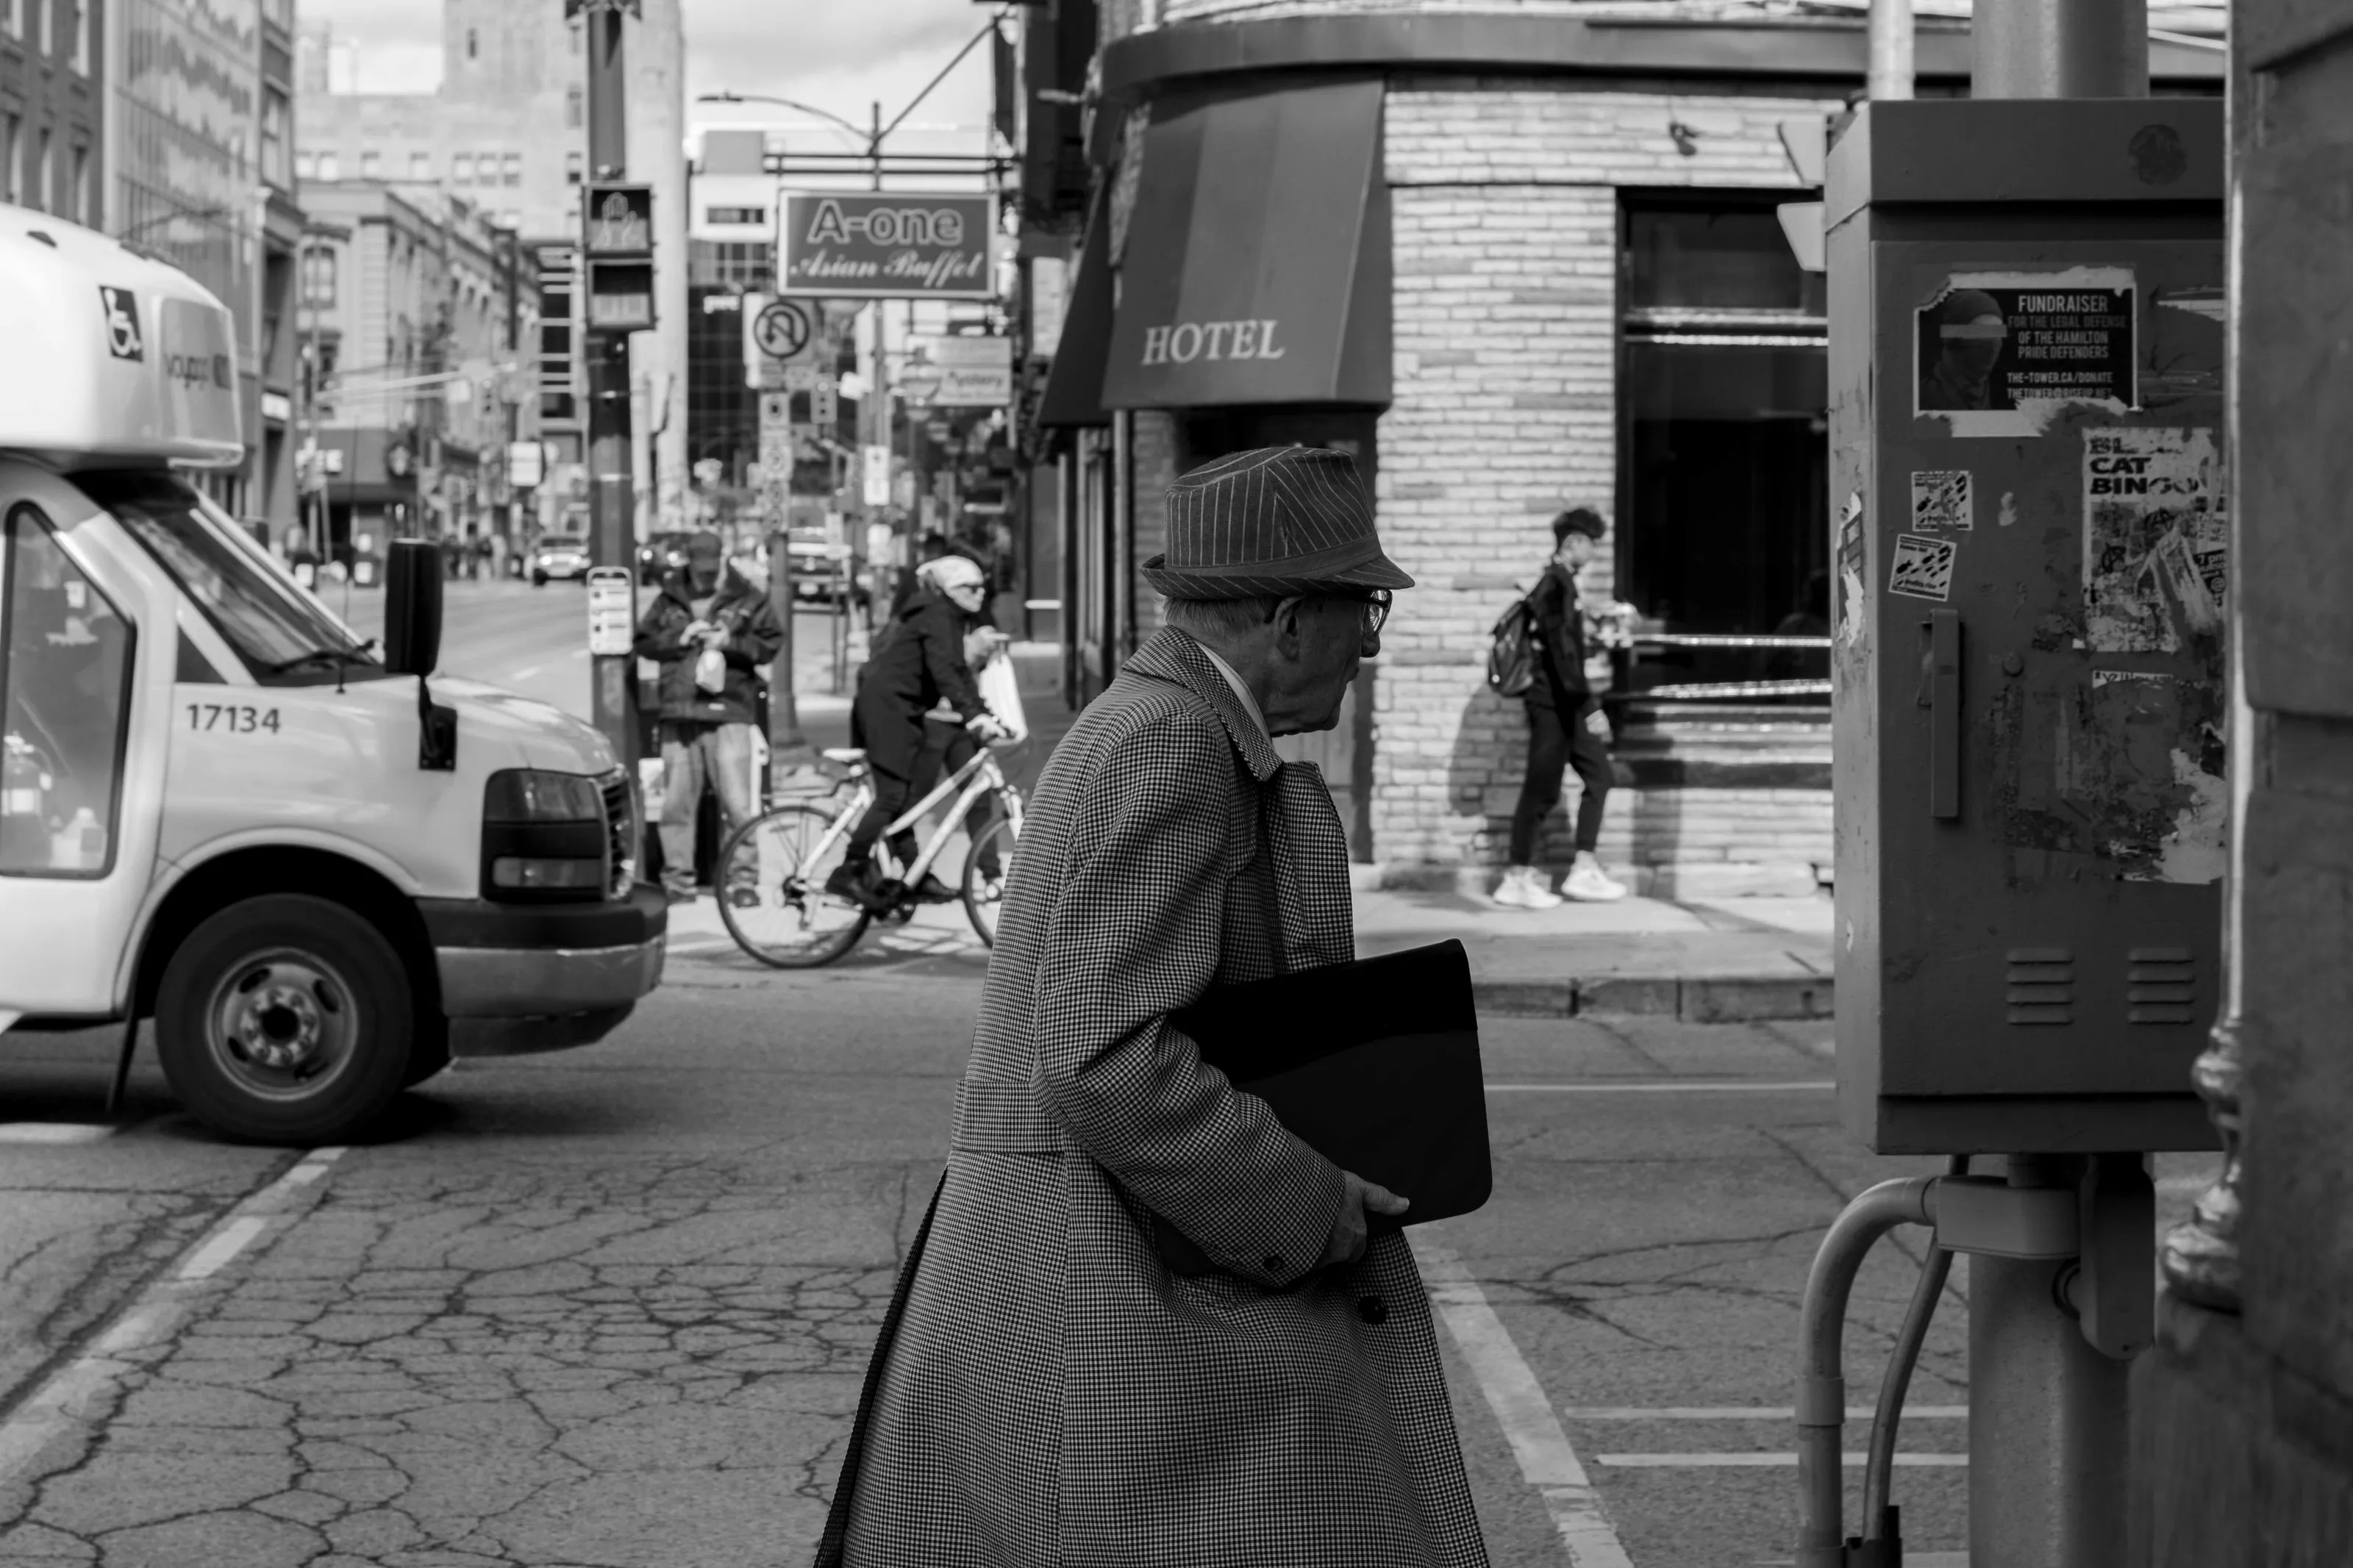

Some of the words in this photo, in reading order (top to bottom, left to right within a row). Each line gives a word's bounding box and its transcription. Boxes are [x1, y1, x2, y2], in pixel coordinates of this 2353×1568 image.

[807, 199, 963, 246] A-one
[789, 248, 878, 277] Asian
[883, 248, 984, 288] Buffet
[2018, 296, 2108, 312] FUNDRAISER
[2008, 315, 2027, 328] FOR
[2029, 315, 2047, 328] THE
[2051, 315, 2081, 328] LEGAL
[2084, 315, 2127, 328] DEFENSE
[1141, 318, 1286, 366] HOTEL
[2018, 331, 2031, 344] OF
[2034, 331, 2054, 344] THE
[2056, 331, 2108, 344] HAMILTON
[2018, 346, 2048, 359] PRIDE
[2050, 346, 2109, 359] DEFENDERS
[2090, 457, 2152, 474] CAT
[186, 704, 280, 734] 17134
